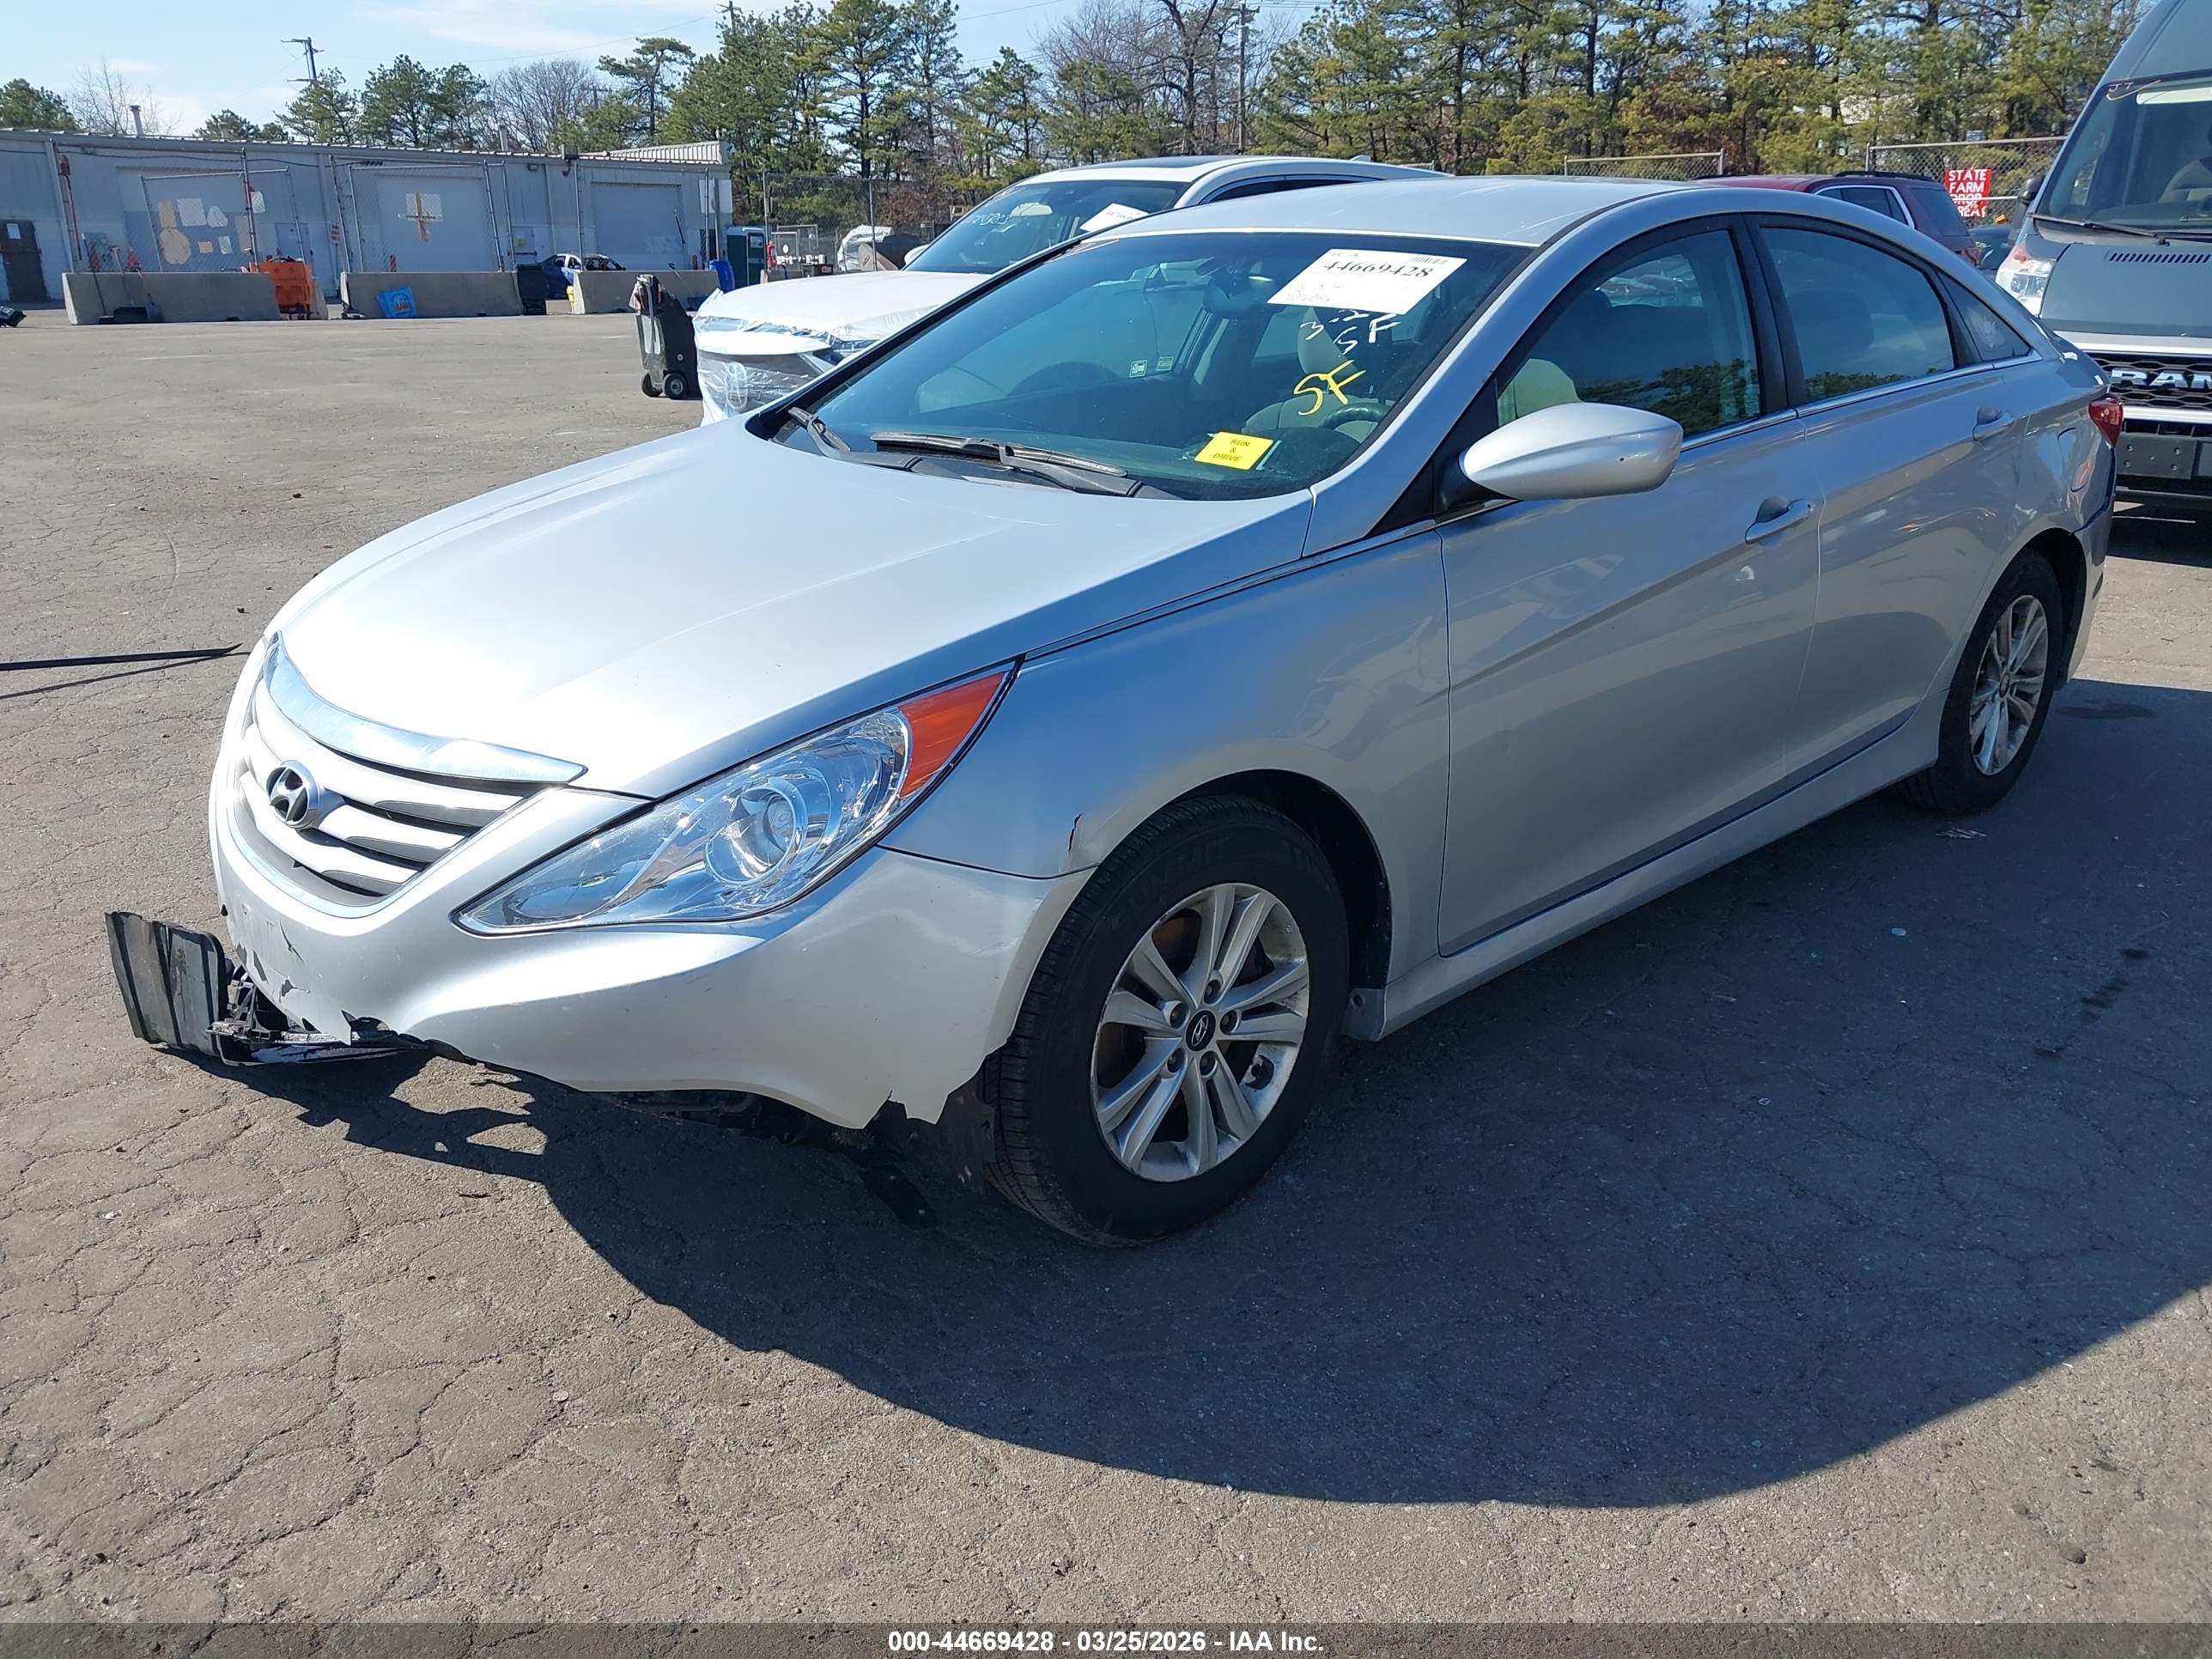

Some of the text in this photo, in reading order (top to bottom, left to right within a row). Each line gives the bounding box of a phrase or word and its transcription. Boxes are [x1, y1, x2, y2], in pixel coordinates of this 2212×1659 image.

[1948, 168, 1988, 181] STATE
[1949, 181, 1985, 193] FARM
[1323, 260, 1435, 278] 44669428
[1230, 439, 1251, 447] RUN
[1212, 453, 1241, 462] DRIVE
